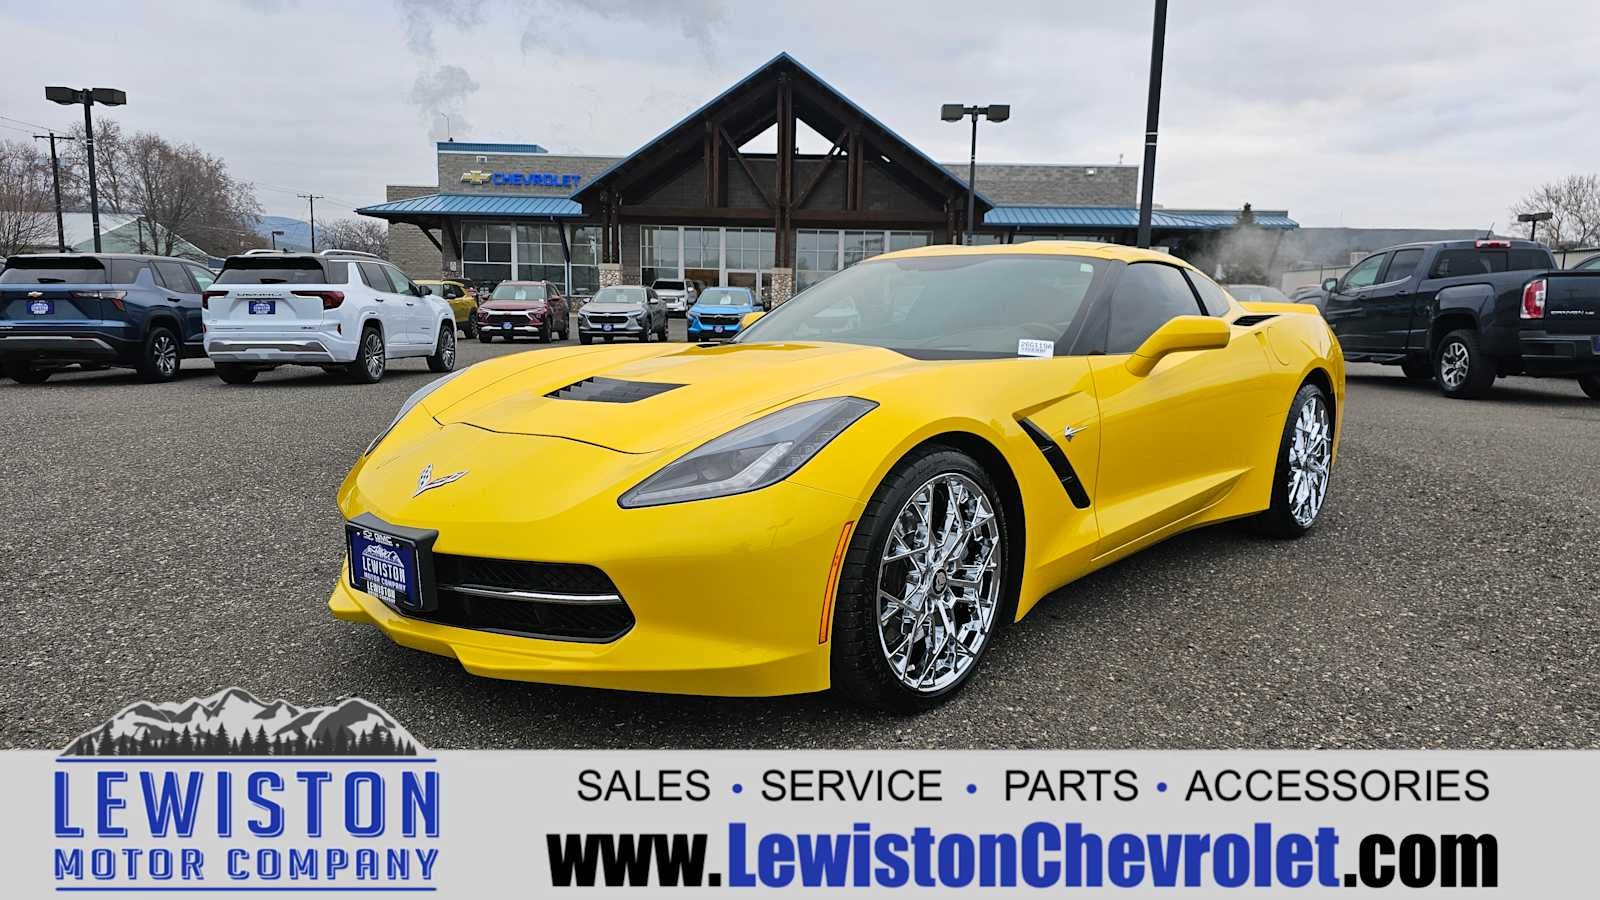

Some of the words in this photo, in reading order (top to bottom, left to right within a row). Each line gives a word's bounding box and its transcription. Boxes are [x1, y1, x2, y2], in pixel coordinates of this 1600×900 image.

[492, 173, 581, 187] CHEVROLET
[362, 556, 406, 583] LEWISTON
[364, 571, 381, 583] MOTOR
[381, 577, 406, 592] COMPANY
[367, 581, 396, 598] LEWISTON
